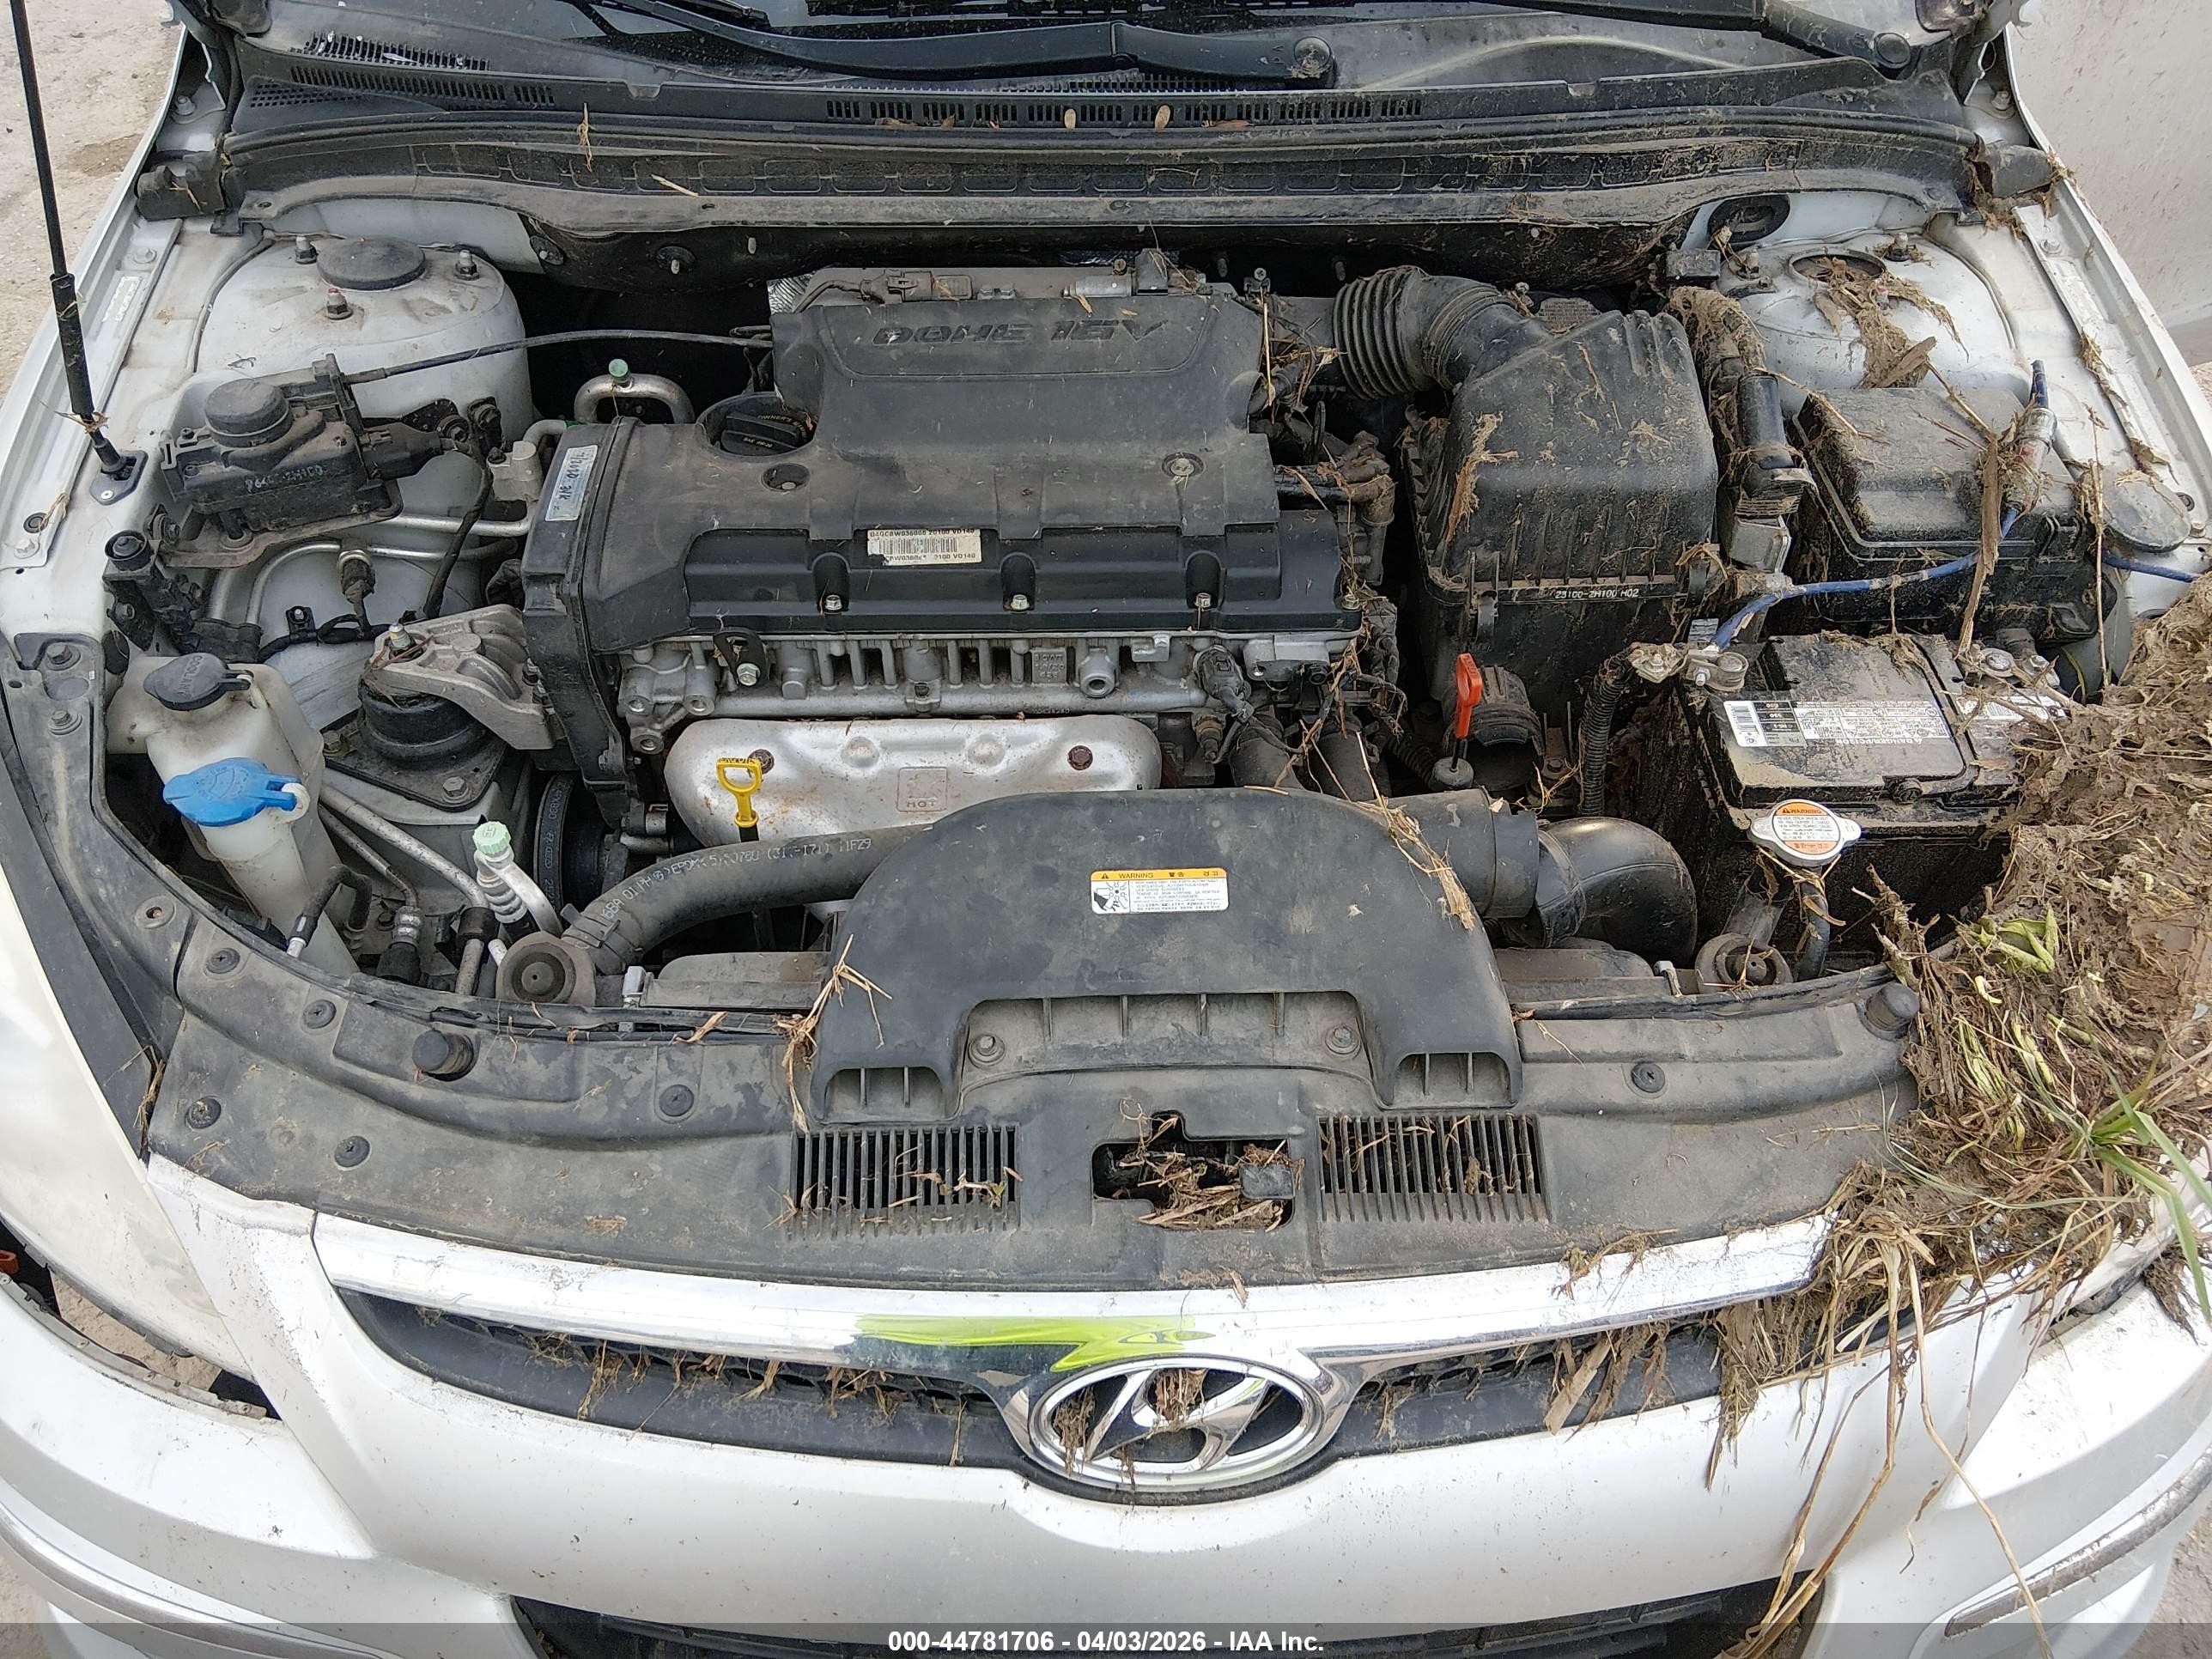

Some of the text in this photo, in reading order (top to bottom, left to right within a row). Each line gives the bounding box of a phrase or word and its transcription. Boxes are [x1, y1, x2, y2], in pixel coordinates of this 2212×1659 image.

[1051, 319, 1169, 343] 16V
[1620, 588, 1639, 598] H02
[178, 654, 204, 696] COOLANT
[906, 799, 937, 809] HOT
[483, 826, 495, 838] H
